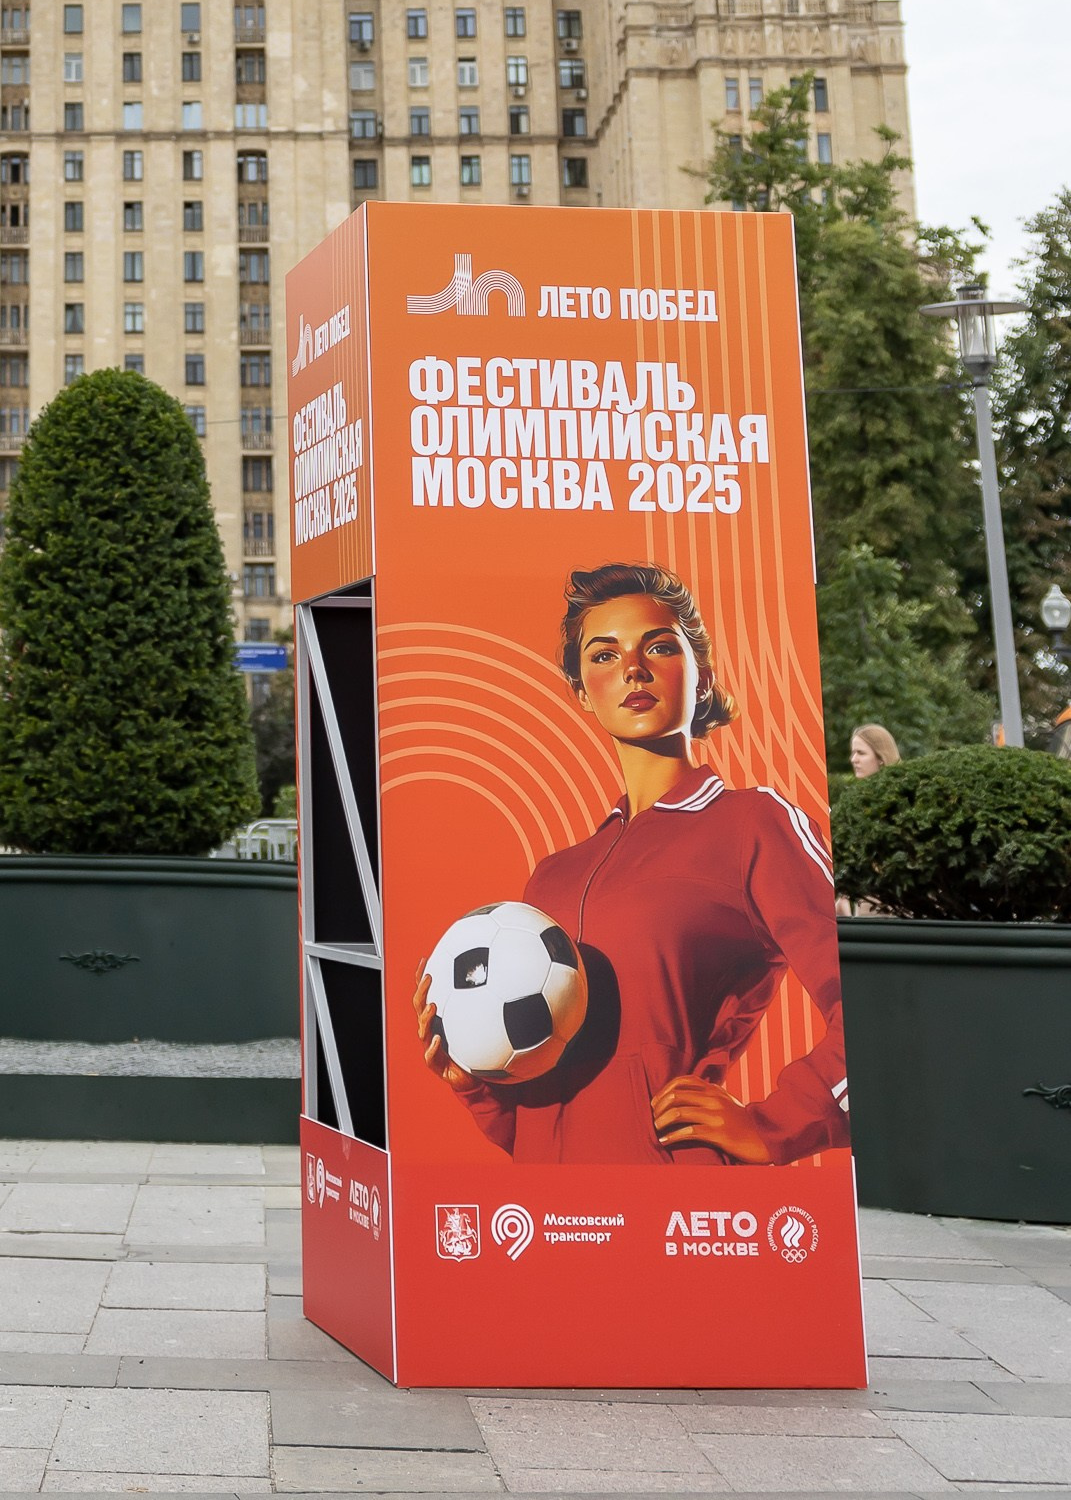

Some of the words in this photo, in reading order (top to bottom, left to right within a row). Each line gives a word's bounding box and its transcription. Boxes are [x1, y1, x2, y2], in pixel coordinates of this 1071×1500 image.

[537, 285, 612, 320] ЛЕТО
[619, 288, 719, 322] ПОБЕД
[314, 320, 329, 360] ЛЕТО
[329, 304, 351, 349] ПОБЕД
[408, 355, 696, 414] ФЕСТИВАЛЬ
[293, 381, 347, 454] ФЕСТИВАЛЬ
[410, 405, 771, 464] ОЛИМПИЙСКАЯ
[294, 418, 364, 501] ОЛИМПИЙСКАЯ
[411, 456, 615, 511] МОСКВА
[628, 462, 742, 514] 2025
[294, 488, 332, 547] МОСКВА
[333, 471, 358, 529] 2025
[543, 1213, 625, 1227] Московский
[544, 1231, 612, 1245] транспорт
[665, 1211, 758, 1238] ЛЕТО
[788, 1205, 815, 1224] КОМИТЕТ
[809, 1224, 819, 1252] РОССИИ
[665, 1242, 678, 1256] В
[683, 1242, 759, 1256] МОСКВЕ
